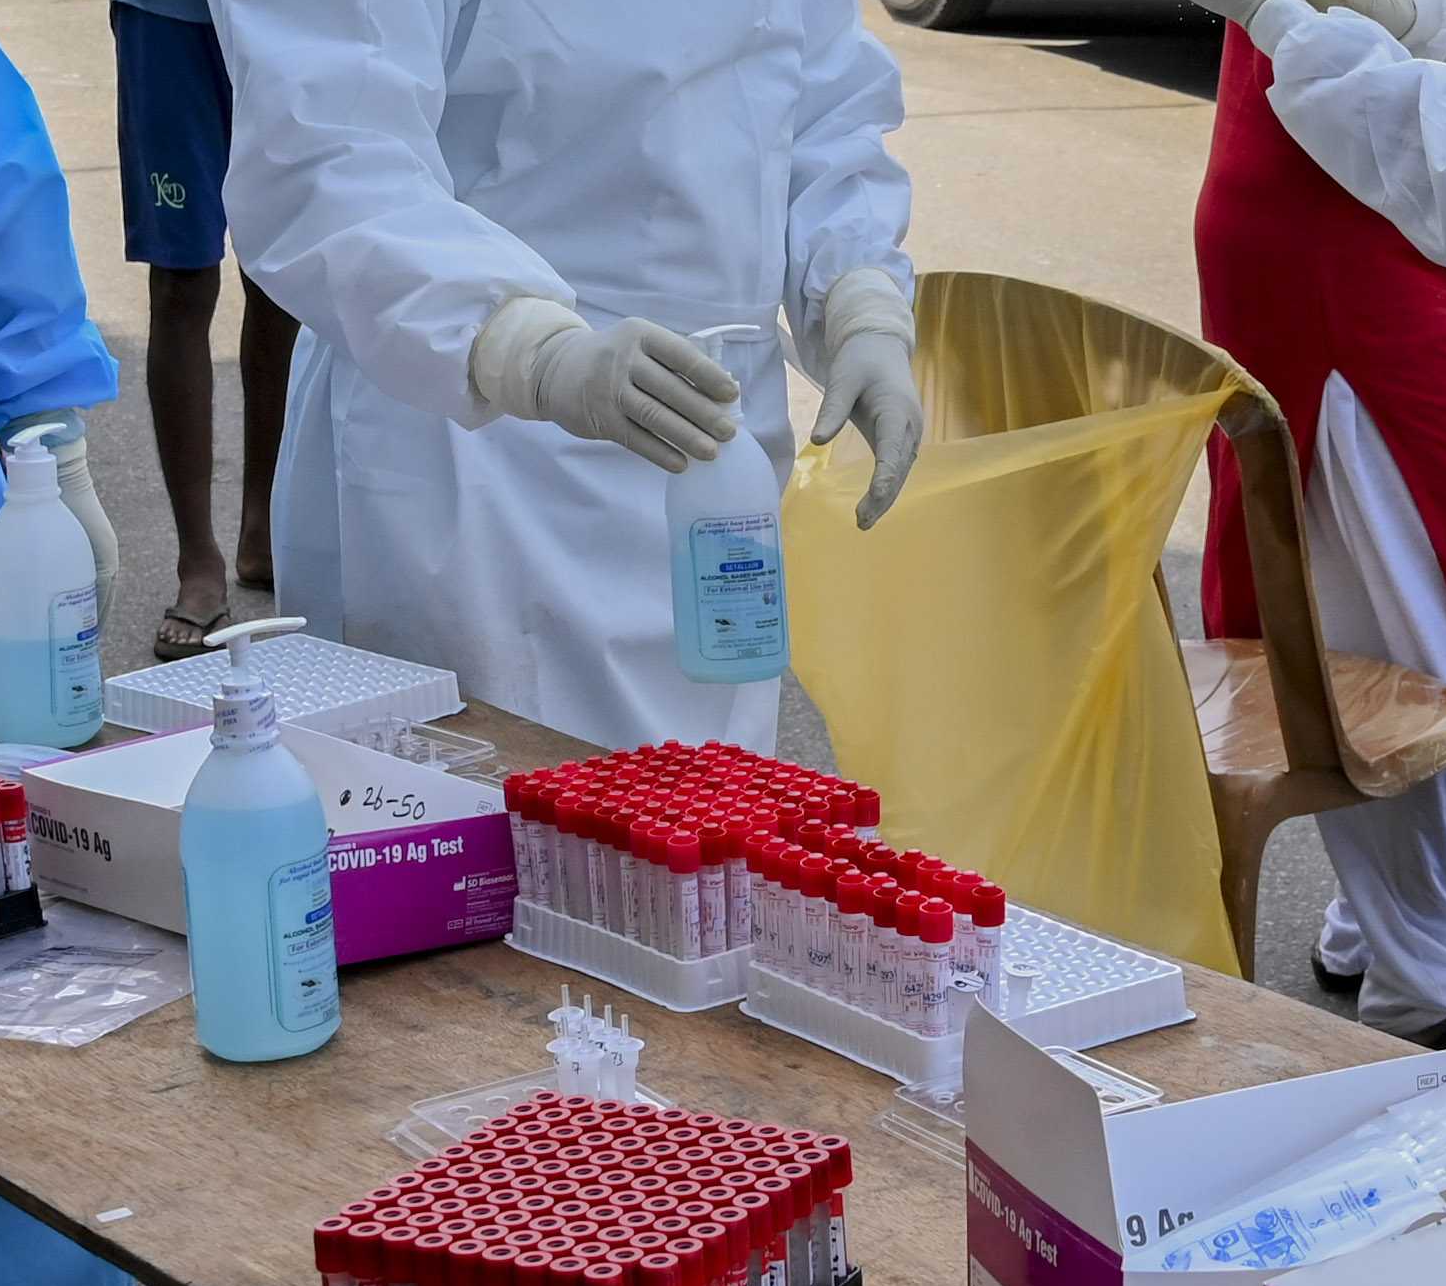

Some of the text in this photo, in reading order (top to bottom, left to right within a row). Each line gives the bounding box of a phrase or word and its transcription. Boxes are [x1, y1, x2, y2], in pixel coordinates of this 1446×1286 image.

[31, 812, 89, 851] COVID-19
[94, 831, 112, 862] Ag
[328, 836, 464, 873] COVID-19 Ag Test
[283, 927, 314, 940] ALCOHOL
[291, 944, 304, 953] For
[973, 1175, 1057, 1267] COVID-19 Ag Test
